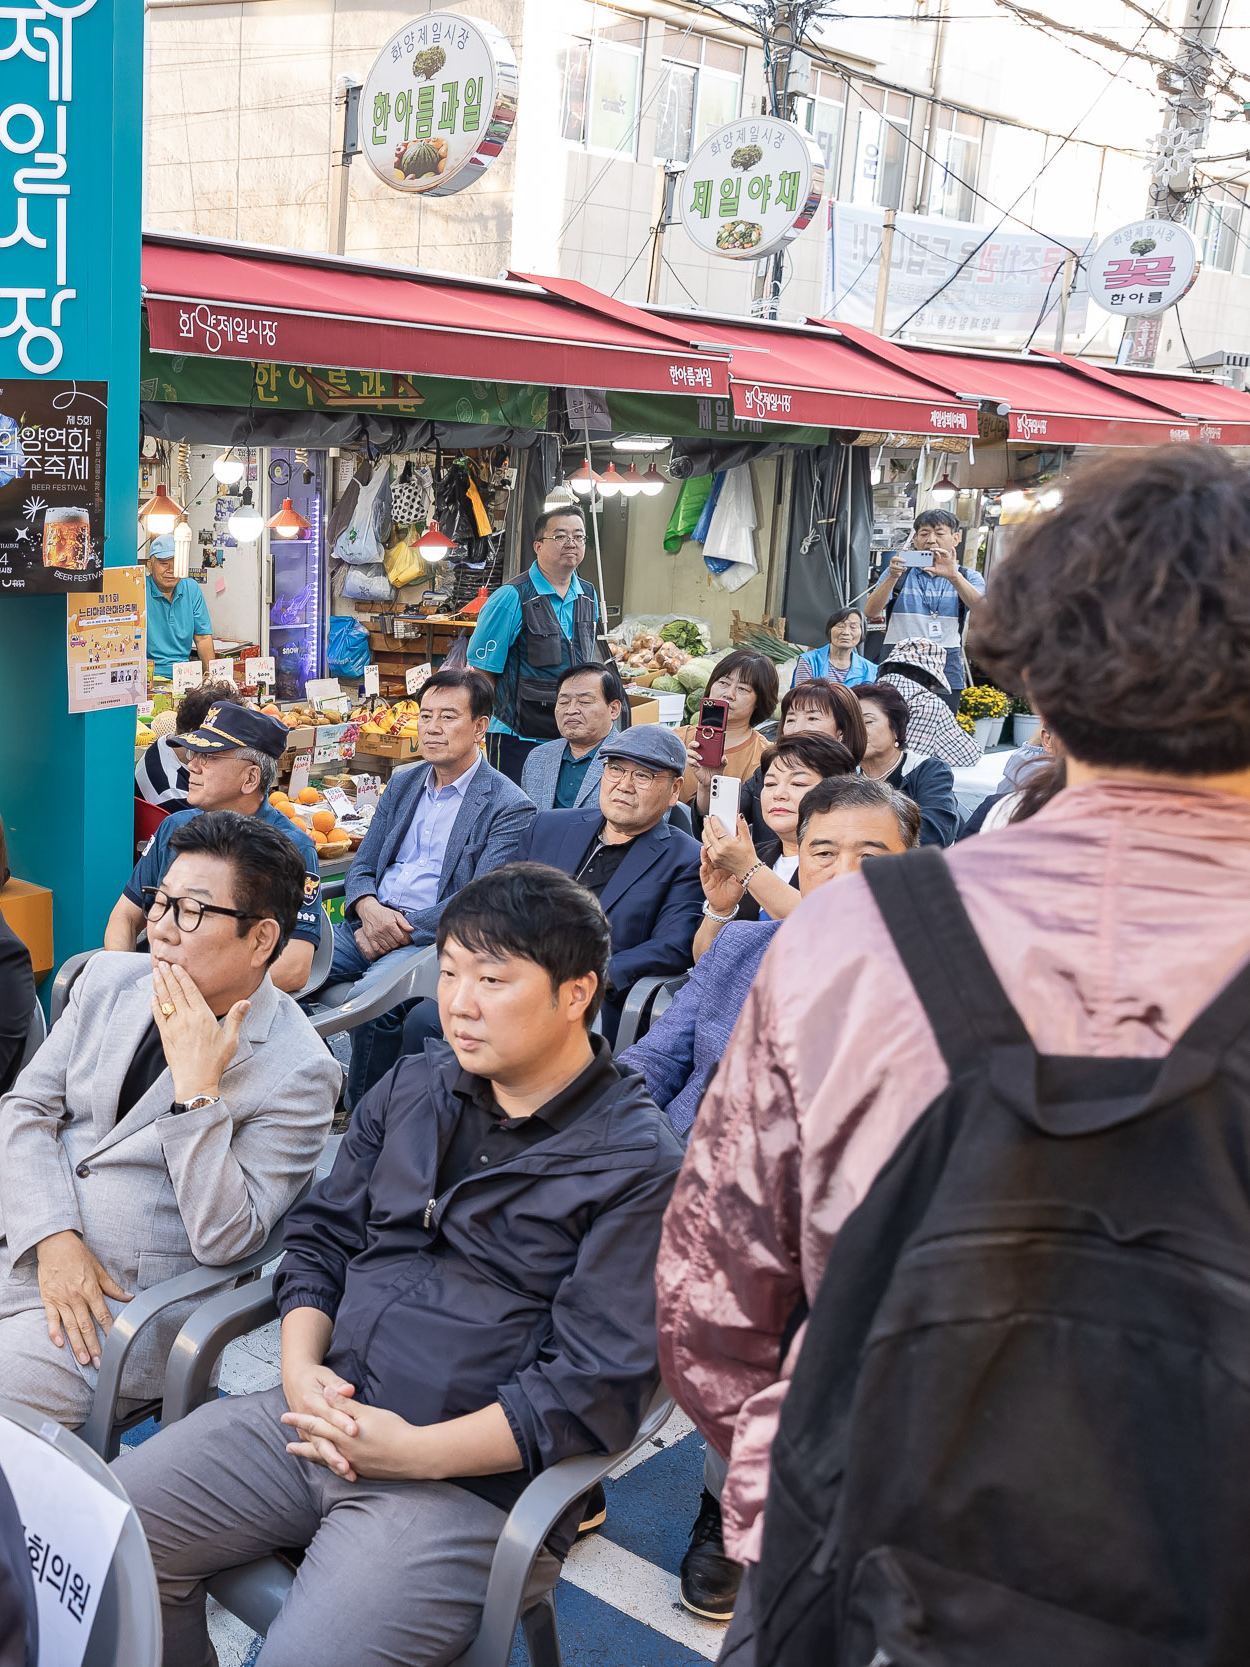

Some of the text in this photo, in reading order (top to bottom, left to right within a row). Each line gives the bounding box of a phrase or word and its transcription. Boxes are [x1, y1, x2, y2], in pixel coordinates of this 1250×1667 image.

[391, 22, 470, 63] 화양제일시장
[372, 77, 483, 145] 한아름과일
[710, 126, 786, 157] 화양제일시장
[690, 171, 801, 219] 제일야채
[1114, 225, 1175, 246] 화양제일시장
[1103, 256, 1176, 290] 꽃
[1110, 291, 1163, 306] 한아름
[180, 304, 278, 352] 화양제일시장
[669, 366, 712, 388] 한아름과일
[745, 385, 792, 418] 화양제일시장
[66, 415, 91, 425] 제 5회
[54, 570, 73, 581] BEER
[23, 1525, 91, 1624] 회의원
